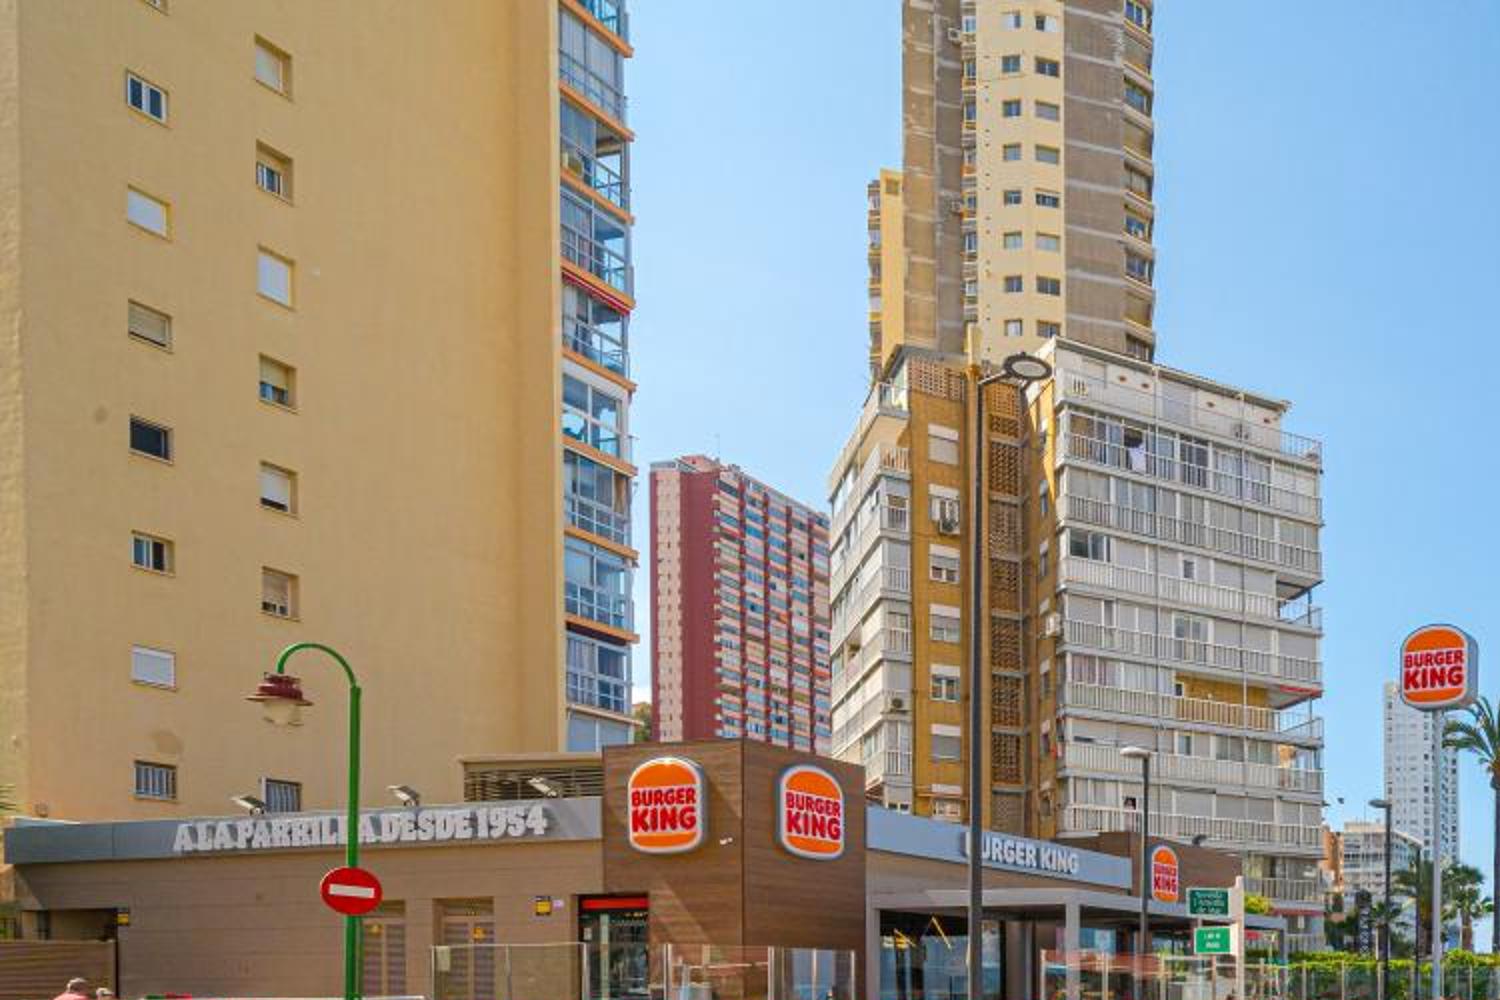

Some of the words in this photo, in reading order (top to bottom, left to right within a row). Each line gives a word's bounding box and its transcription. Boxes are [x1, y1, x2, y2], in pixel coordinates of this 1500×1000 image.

[1404, 650, 1464, 668] BURGER
[1404, 666, 1464, 690] KING
[631, 787, 697, 806] BURGER
[785, 792, 841, 817] BURGER
[173, 823, 194, 851] A
[199, 820, 233, 850] LA
[381, 809, 475, 842] DESDE
[476, 804, 547, 839] 1954
[632, 806, 697, 832] KING
[786, 810, 841, 840] KING
[1040, 846, 1080, 875] KING
[1154, 874, 1177, 892] KING
